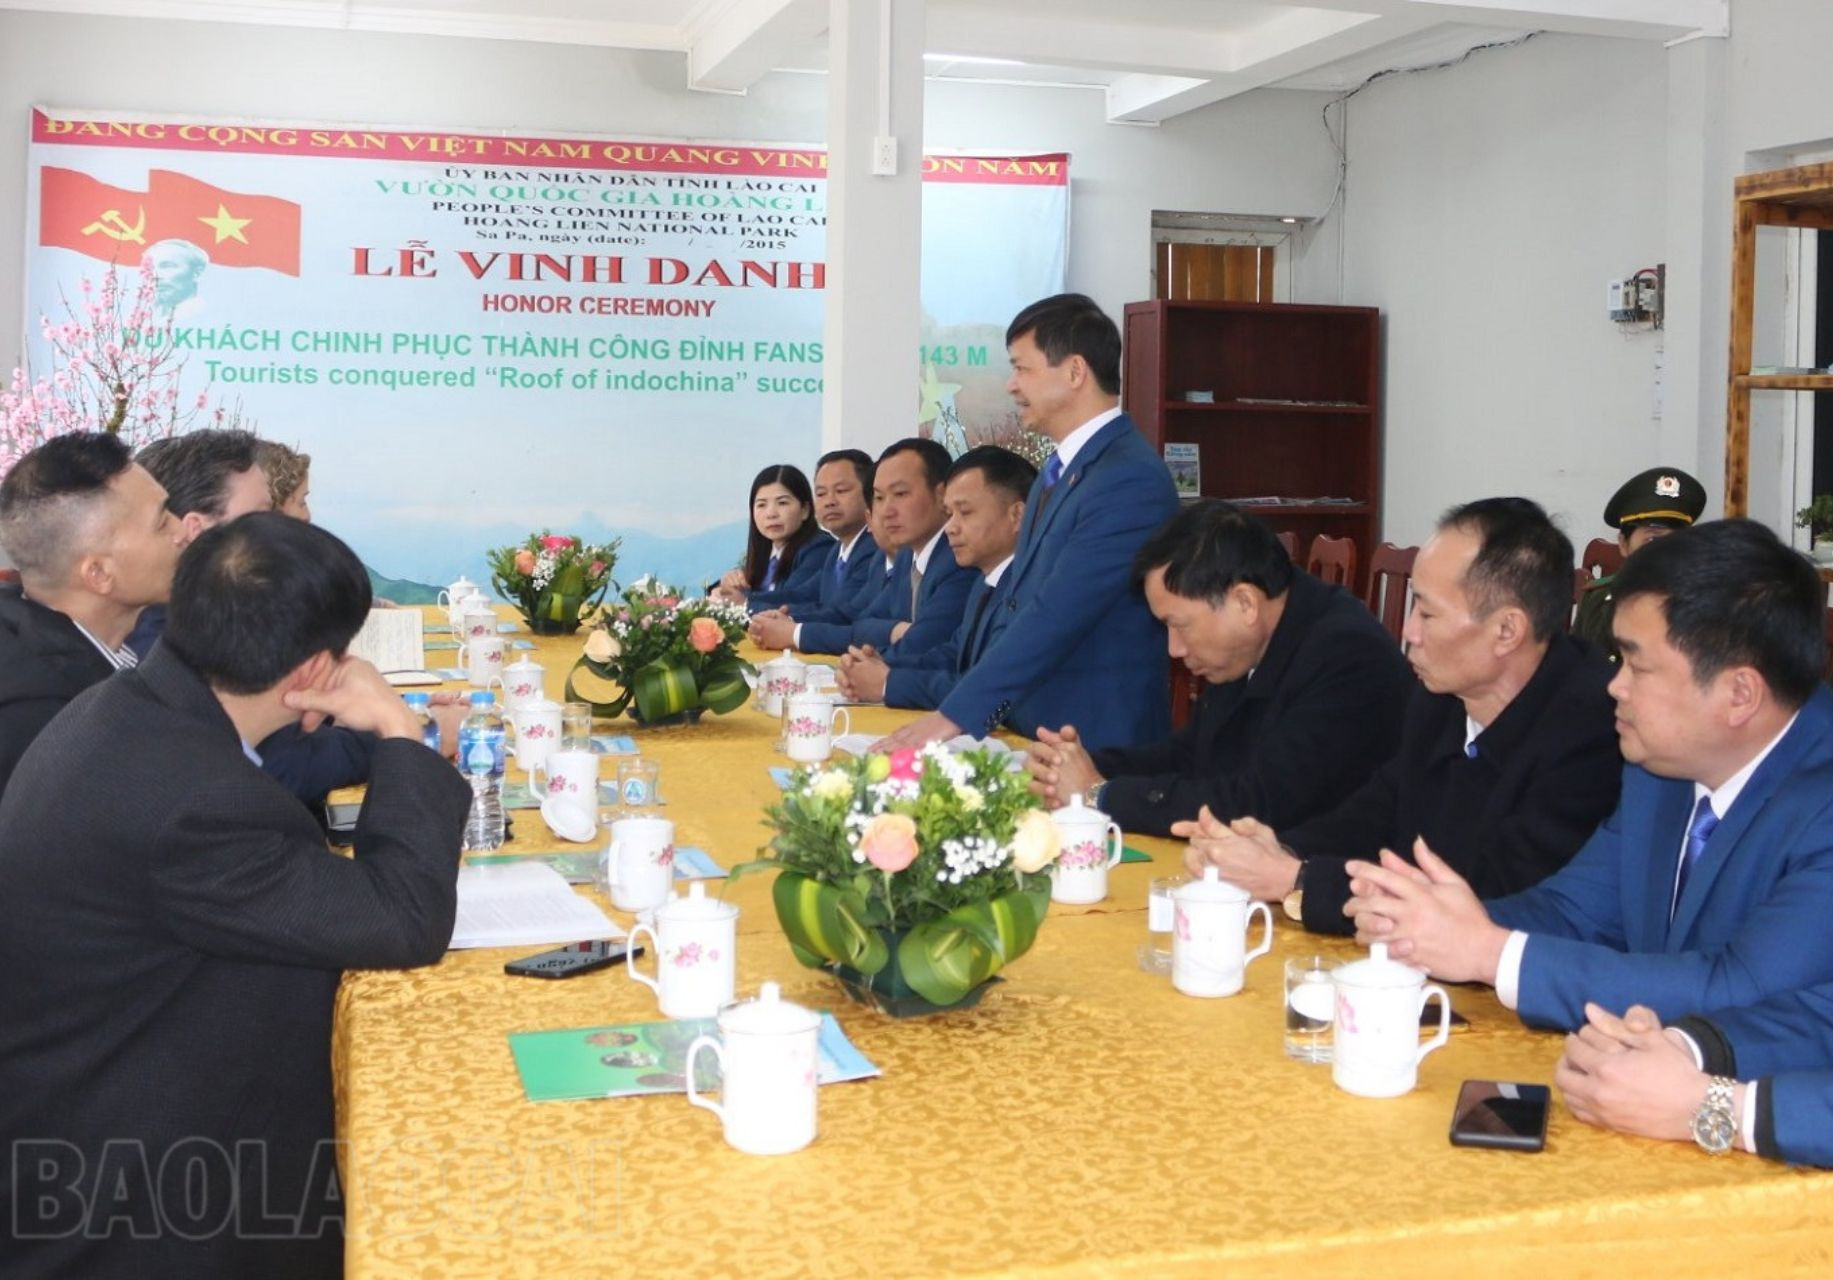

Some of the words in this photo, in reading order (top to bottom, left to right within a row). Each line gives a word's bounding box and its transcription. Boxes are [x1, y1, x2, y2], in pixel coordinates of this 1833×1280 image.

[504, 140, 593, 159] NAM
[603, 144, 739, 166] QUANG
[484, 170, 530, 181] BAN
[537, 171, 603, 184] NHÂN
[611, 174, 657, 186] DÂN
[779, 182, 817, 193] CAI
[600, 190, 661, 206] GIA
[672, 191, 793, 211] HOÀNG
[804, 198, 823, 211] L
[463, 215, 549, 229] HOANG
[556, 219, 610, 231] LIEN
[617, 222, 735, 236] NATIONAL
[740, 226, 798, 238] PARK
[550, 206, 694, 222] COMMITTEE
[702, 211, 732, 222] OF
[737, 213, 783, 224] LAO
[789, 215, 826, 226] CAI
[476, 229, 498, 239] Sa
[588, 234, 646, 246] (date):
[349, 239, 438, 278] LỄ
[453, 251, 630, 283] VINH
[646, 256, 826, 289] DANH
[483, 293, 573, 315] HONOR
[579, 296, 717, 318] CEREMONY
[174, 324, 281, 351] KHÁCH
[291, 330, 383, 354] CHINH
[392, 333, 472, 360] PHỤC
[481, 331, 580, 358] THÀNH
[588, 333, 671, 360] CÔNG
[678, 335, 745, 361] ĐỈNH
[754, 341, 824, 364] FANS
[919, 345, 959, 366] 143
[966, 345, 988, 366] M
[204, 360, 319, 385] Tourists
[328, 366, 476, 391] conquered
[571, 368, 599, 390] of
[756, 375, 823, 393] succ
